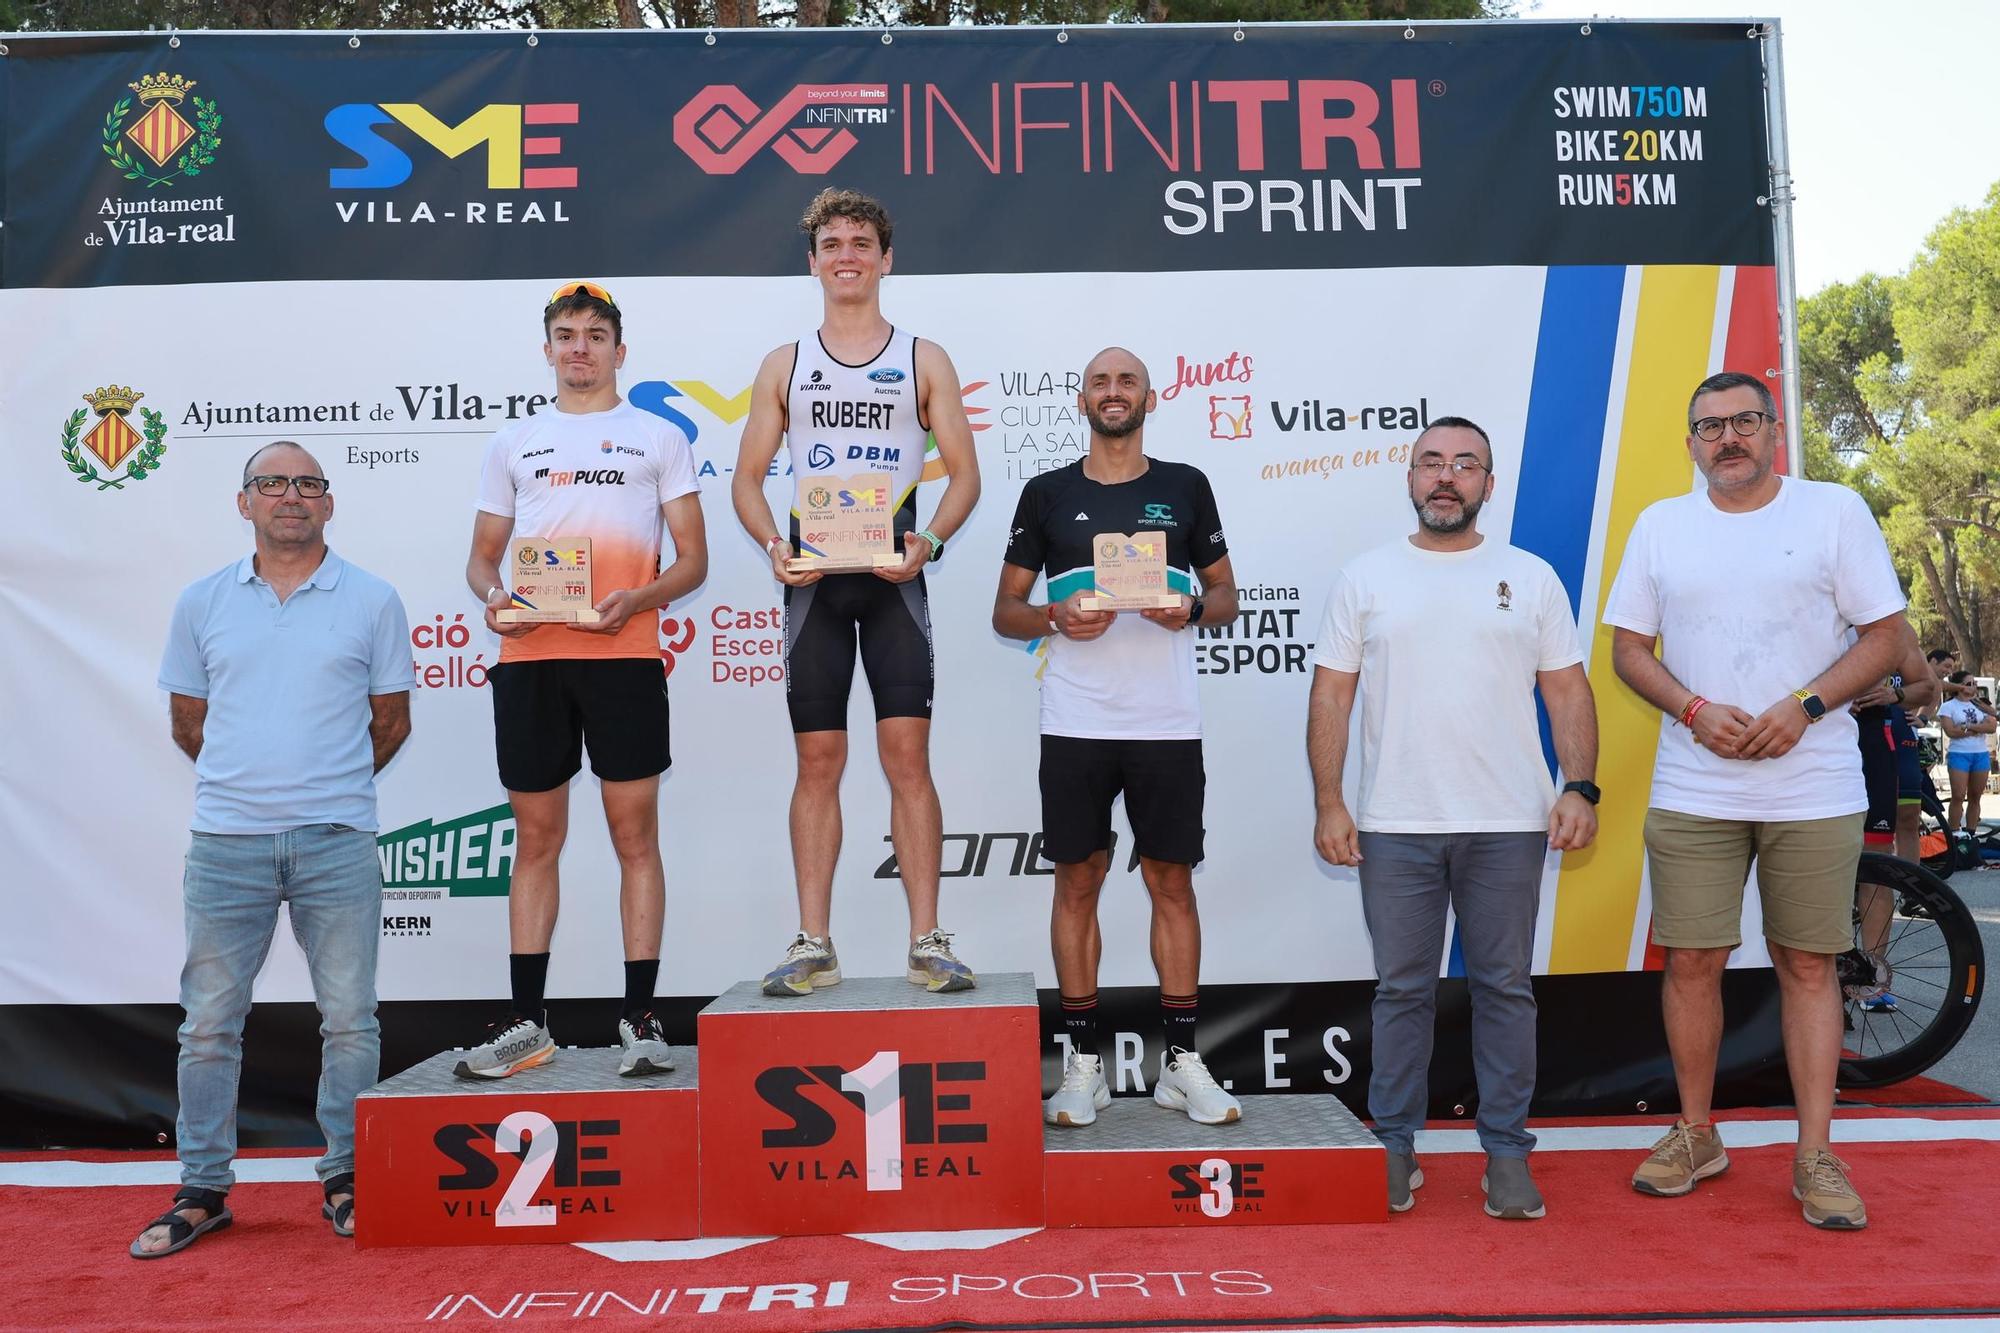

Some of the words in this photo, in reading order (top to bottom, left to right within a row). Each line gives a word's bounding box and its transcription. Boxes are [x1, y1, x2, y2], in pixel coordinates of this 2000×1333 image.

[807, 90, 839, 99] beyond
[860, 90, 886, 98] limits
[806, 108, 887, 123] INFINITRI
[903, 78, 1422, 175] INFINITRI
[324, 103, 579, 189] SME
[98, 196, 224, 220] Ajuntament
[336, 202, 570, 224] VILA-REAL
[1163, 178, 1422, 236] SPRINT
[84, 233, 104, 246] de
[103, 214, 236, 246] Vila-real
[876, 371, 899, 380] Ford
[1161, 352, 1255, 400] Junts
[875, 387, 901, 395] Aucresa
[182, 401, 360, 432] Ajuntament
[370, 404, 394, 422] de
[395, 383, 558, 421] Vila-re
[812, 401, 894, 430] RUBERT
[1271, 398, 1430, 432] Vila-real
[523, 448, 554, 459] MUUR
[616, 446, 645, 458] Puçol
[847, 445, 900, 462] DBM
[1004, 433, 1039, 454] LA
[1046, 432, 1091, 453] SAL
[347, 446, 419, 469] Esports
[871, 463, 899, 471] Pumps
[1261, 454, 1344, 480] avança
[1352, 447, 1380, 468] en
[1387, 441, 1415, 464] es
[549, 469, 625, 486] TRIPUÇOL
[1007, 460, 1011, 480] i
[838, 488, 886, 507] SME
[544, 550, 585, 565] SME
[408, 890, 441, 900] DEPORTIVA
[383, 916, 431, 929] KERN
[495, 1034, 539, 1061] BROOKS
[841, 1051, 902, 1191] 1
[495, 1111, 558, 1227] 2
[1200, 1159, 1233, 1218] 3
[426, 1281, 849, 1320] INFINITRI
[889, 1271, 1272, 1303] SPORTS
